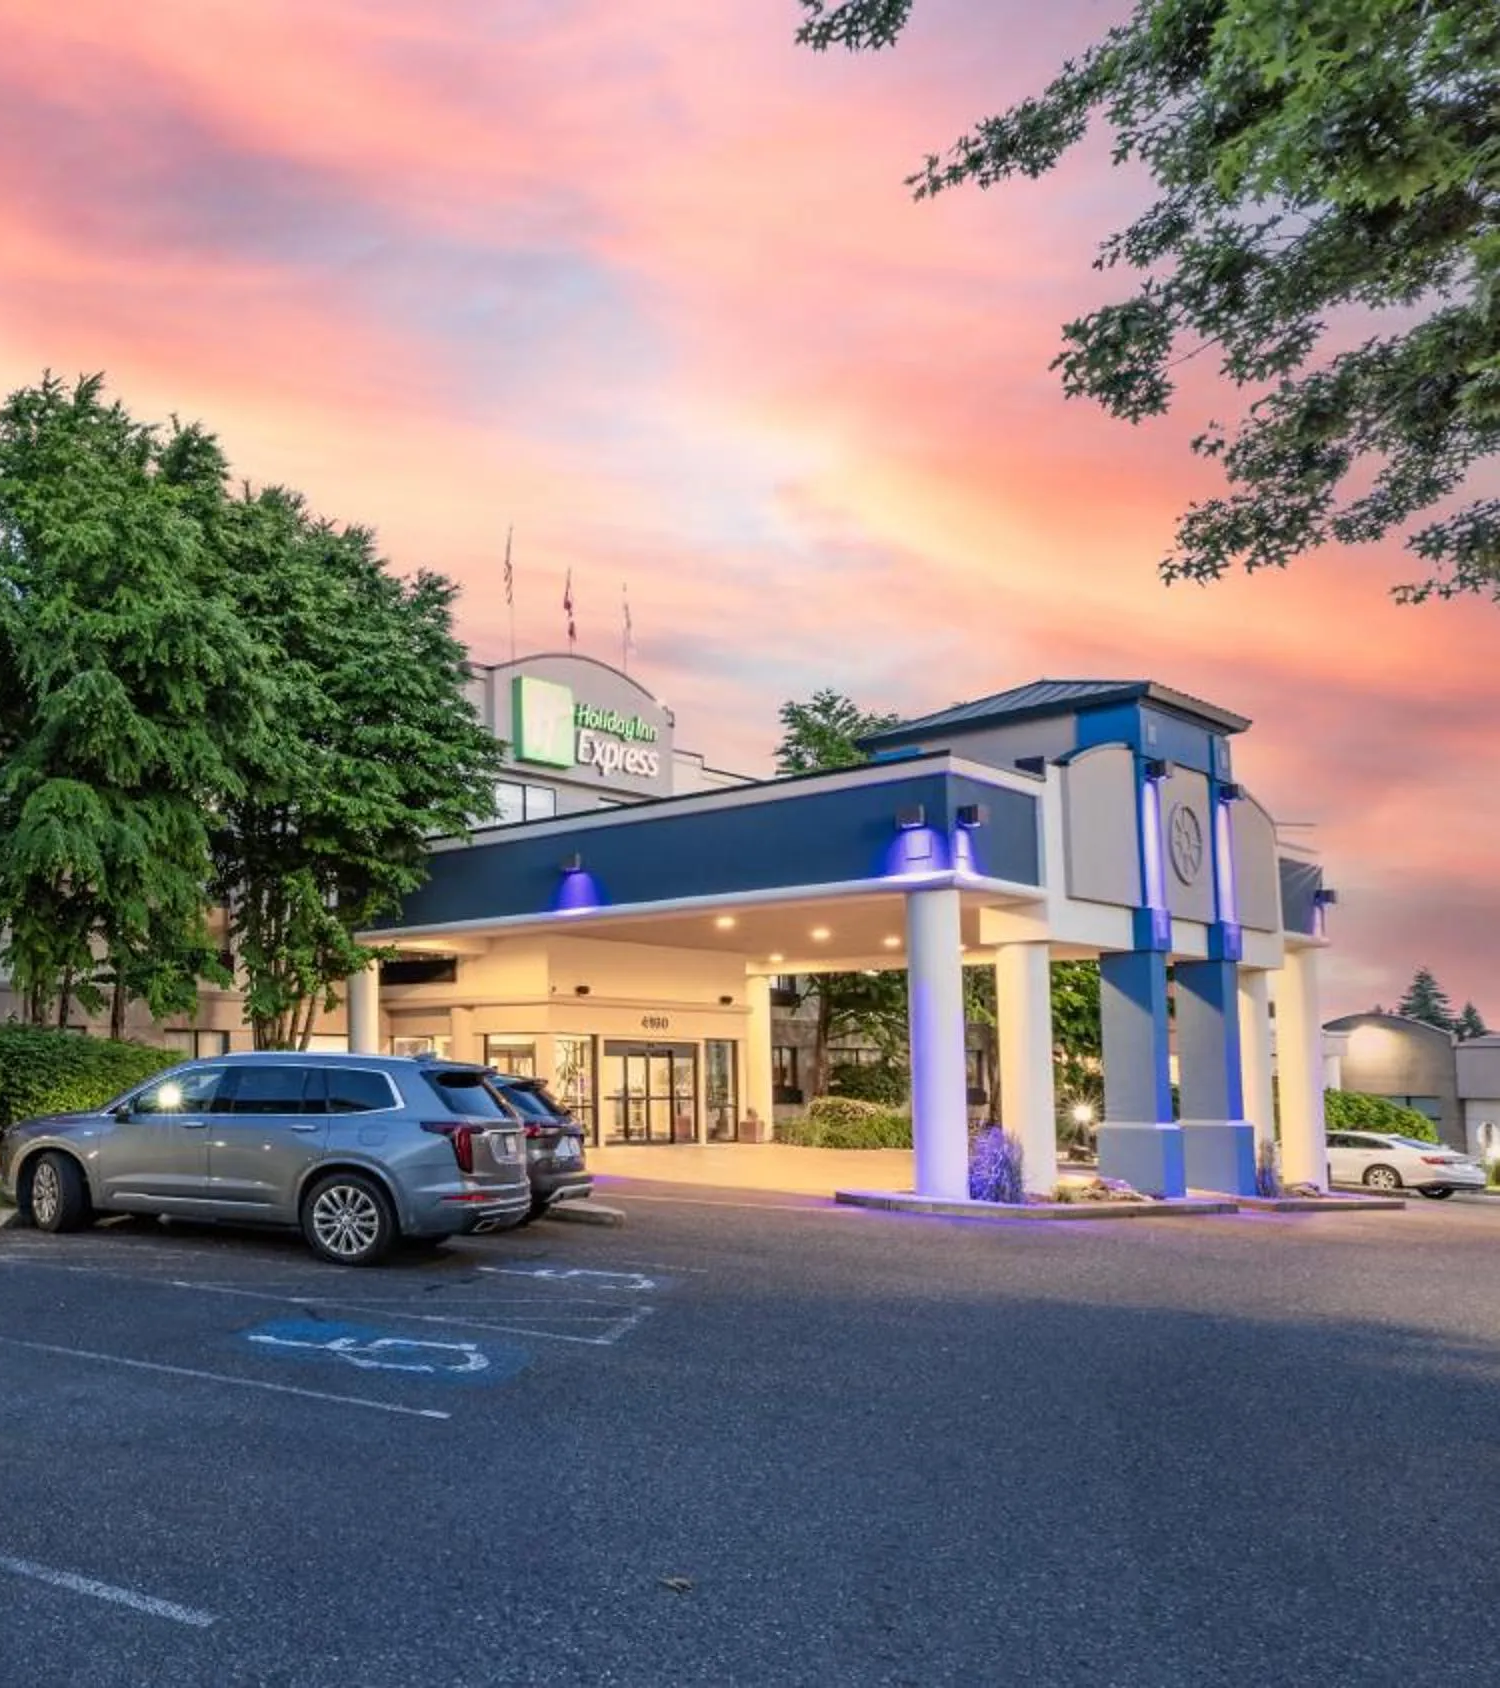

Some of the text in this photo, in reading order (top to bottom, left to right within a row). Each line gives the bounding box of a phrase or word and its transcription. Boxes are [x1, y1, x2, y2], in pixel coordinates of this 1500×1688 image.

[576, 703, 659, 742] Holiday Inn
[577, 728, 660, 776] Express
